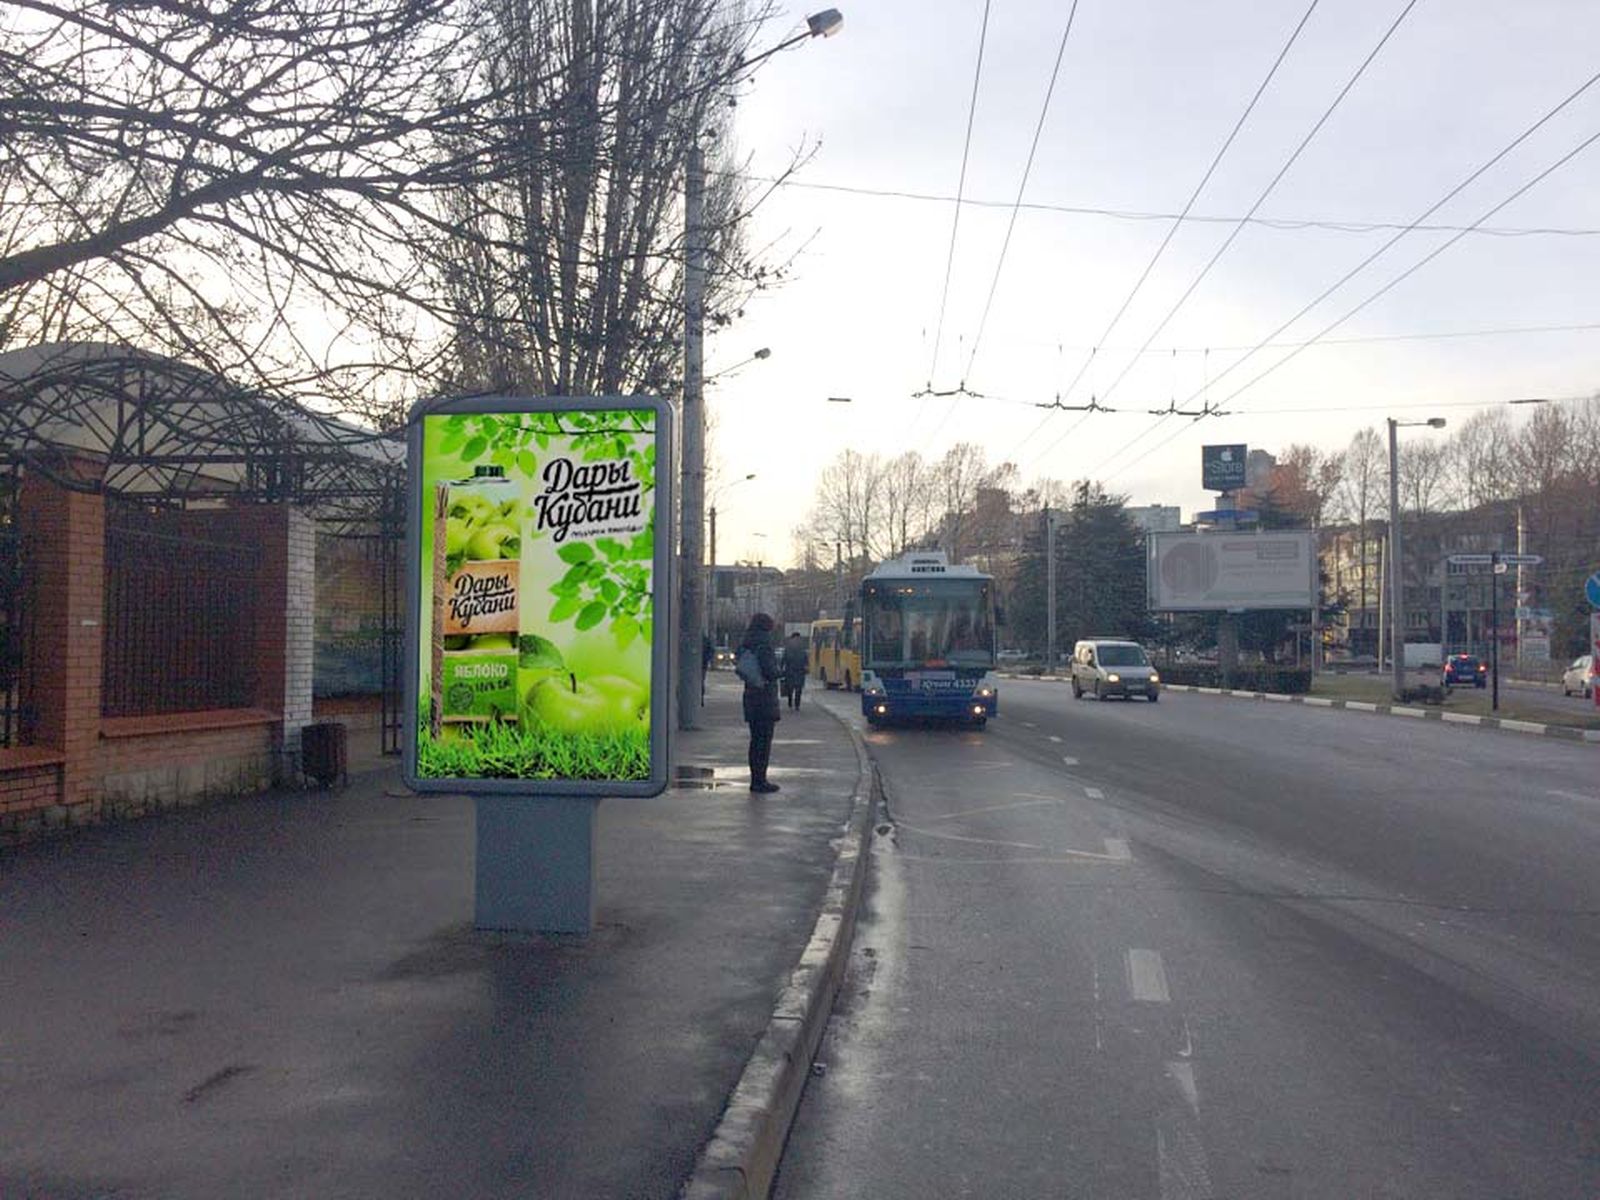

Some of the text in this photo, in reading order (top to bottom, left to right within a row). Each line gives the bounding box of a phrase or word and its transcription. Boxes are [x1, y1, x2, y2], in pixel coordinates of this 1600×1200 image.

[542, 458, 631, 498] Дары
[534, 493, 642, 542] Кубани
[454, 573, 511, 600] Дары
[448, 596, 516, 628] Кубани
[454, 663, 508, 679] ЯБЛОКО
